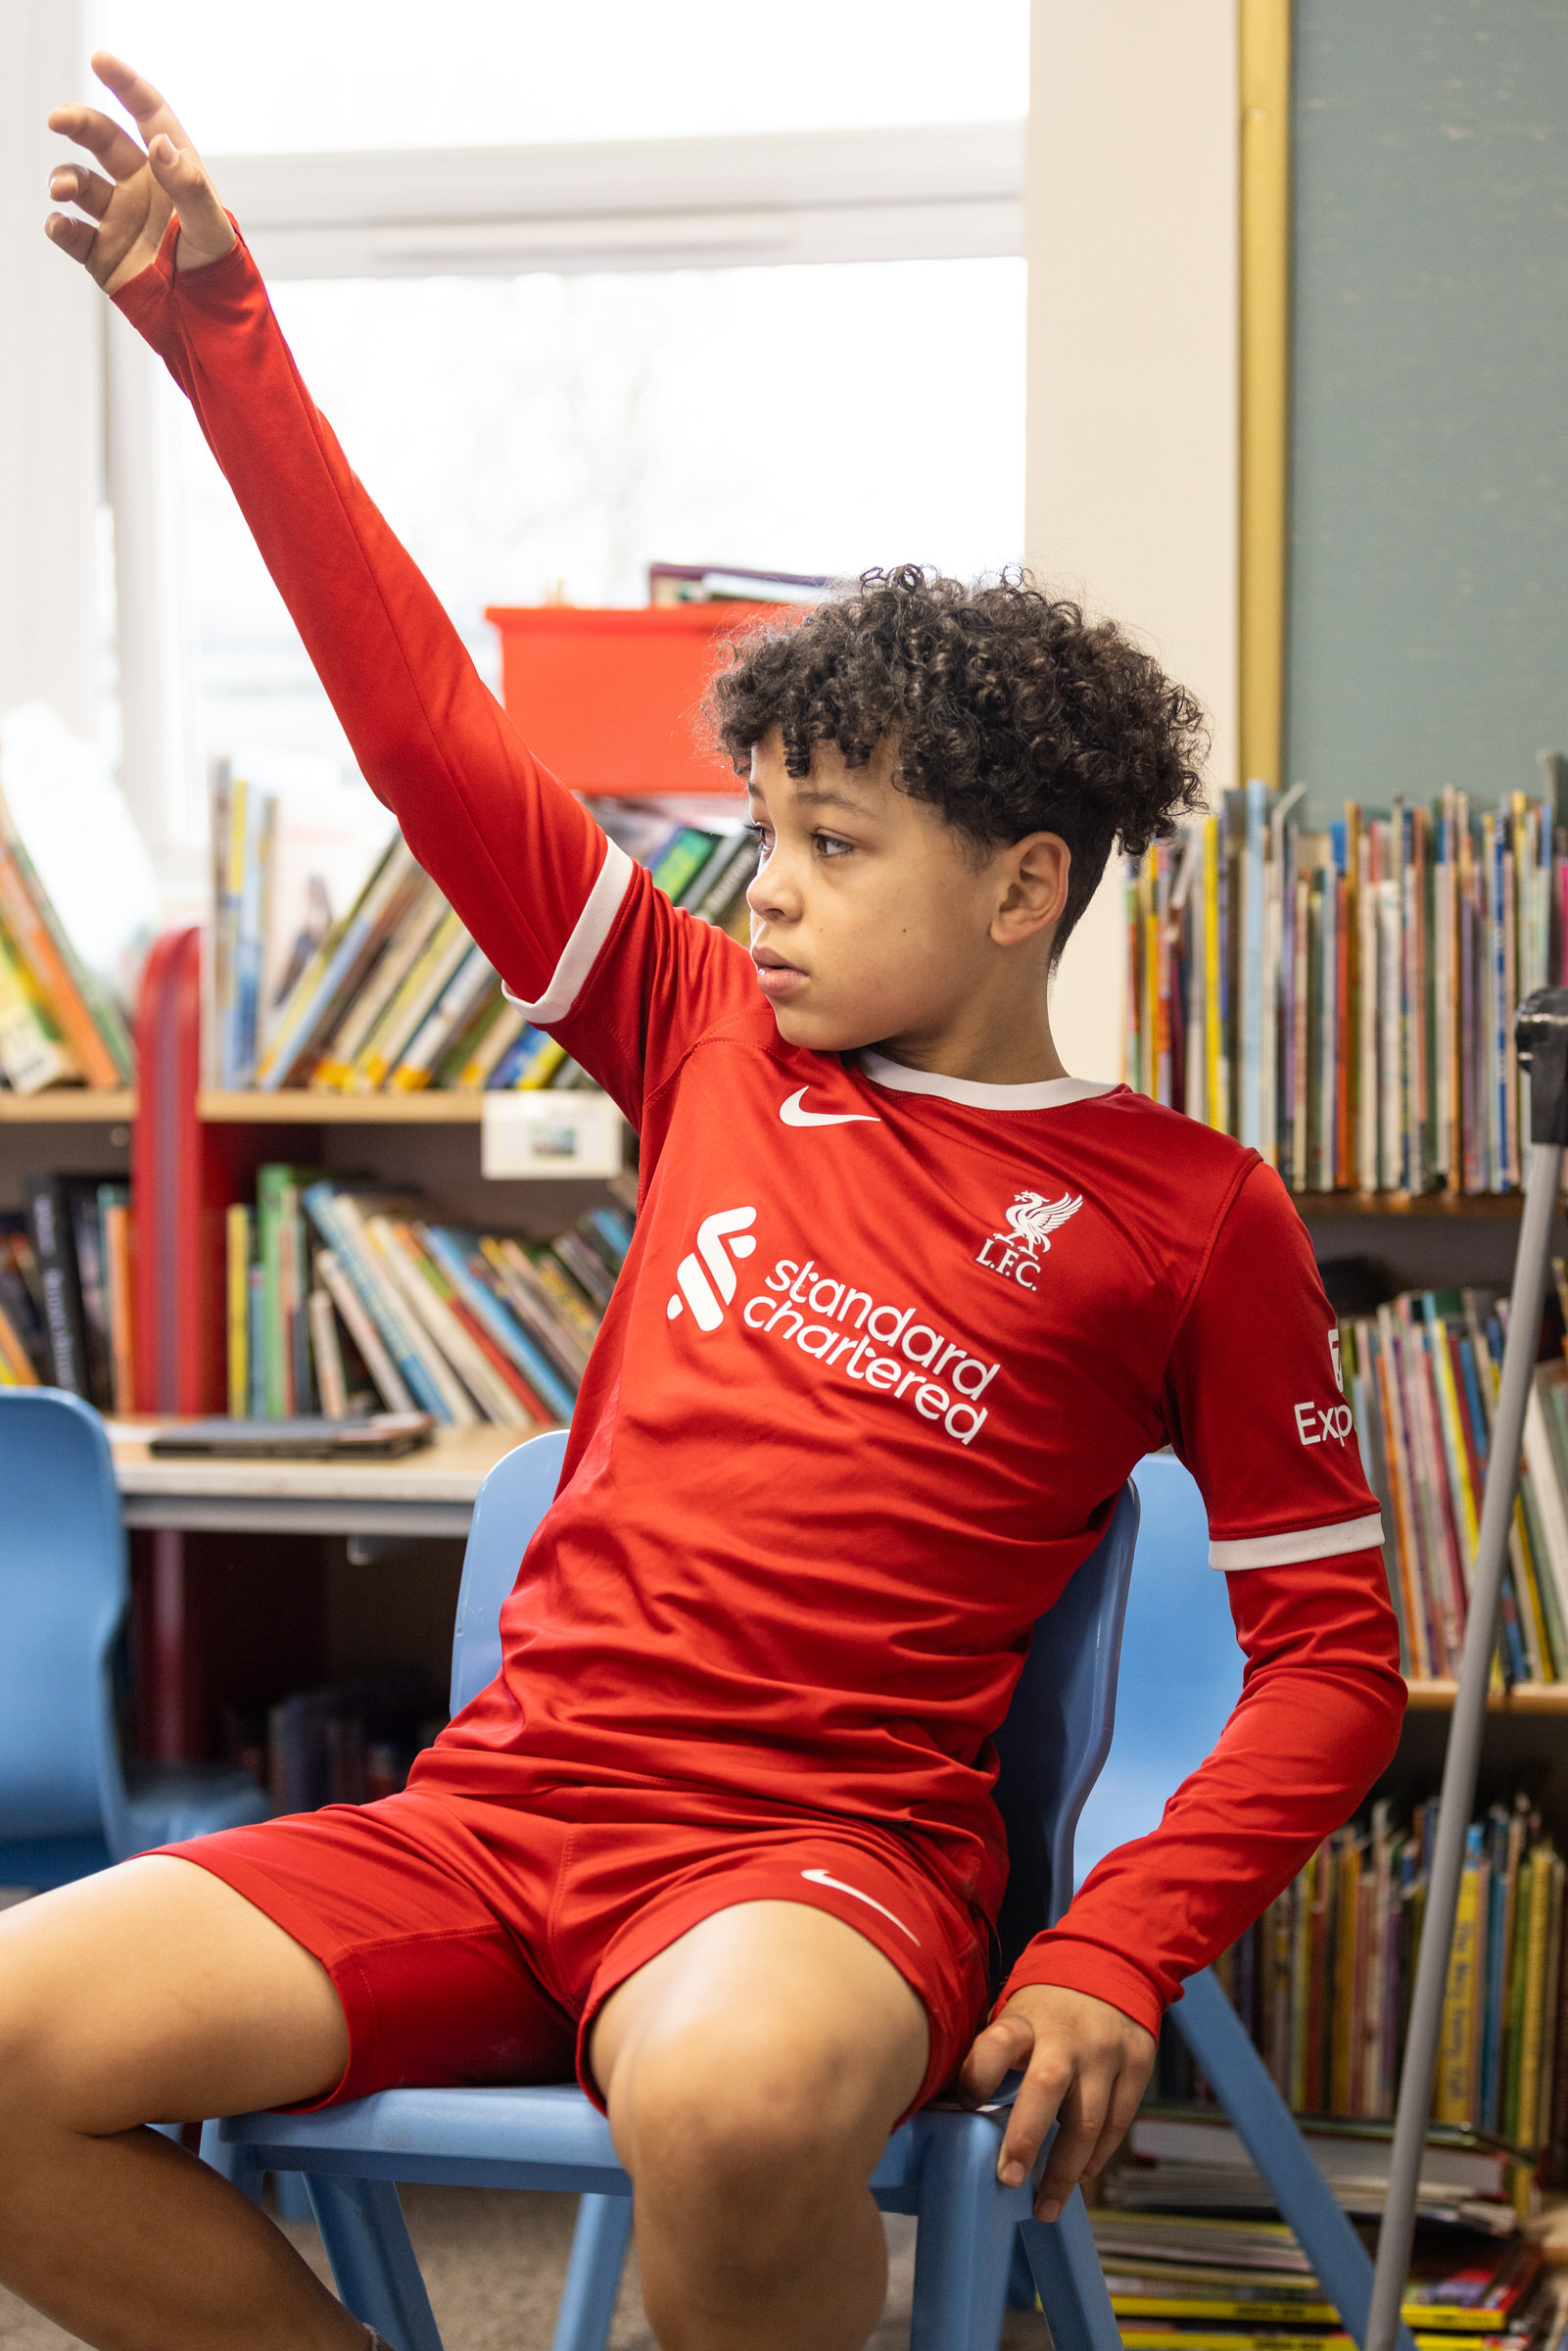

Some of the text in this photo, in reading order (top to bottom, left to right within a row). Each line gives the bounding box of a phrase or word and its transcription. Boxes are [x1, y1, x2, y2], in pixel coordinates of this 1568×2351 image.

[975, 1238, 1042, 1292] L.F.C.
[743, 1295, 988, 1445] chartered
[765, 1259, 1000, 1401] standard
[1294, 1401, 1358, 1447] Exp
